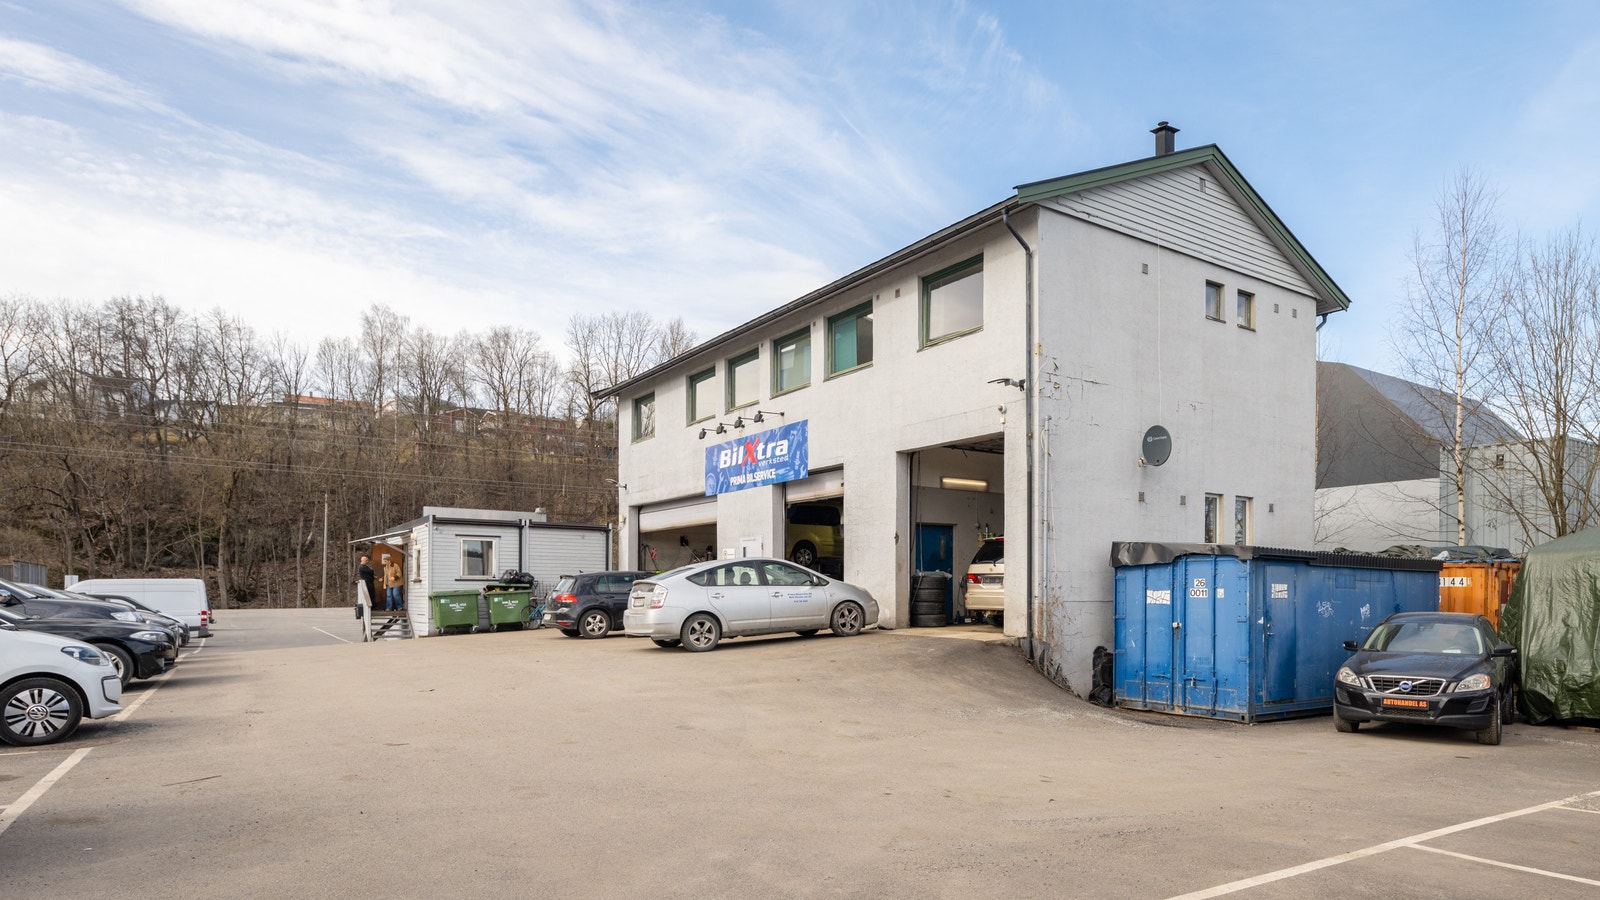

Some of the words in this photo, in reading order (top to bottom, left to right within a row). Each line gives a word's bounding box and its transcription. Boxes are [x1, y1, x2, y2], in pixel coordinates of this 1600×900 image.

[719, 436, 789, 469] BilXtra
[758, 454, 789, 468] verksted
[730, 474, 747, 487] PRIMA
[746, 468, 776, 484] BILSERVICE
[1195, 579, 1206, 587] 26
[1439, 577, 1465, 586] 144
[1189, 589, 1208, 597] 0011
[1383, 698, 1419, 707] AUTOHANDEL
[1418, 700, 1427, 708] AS
